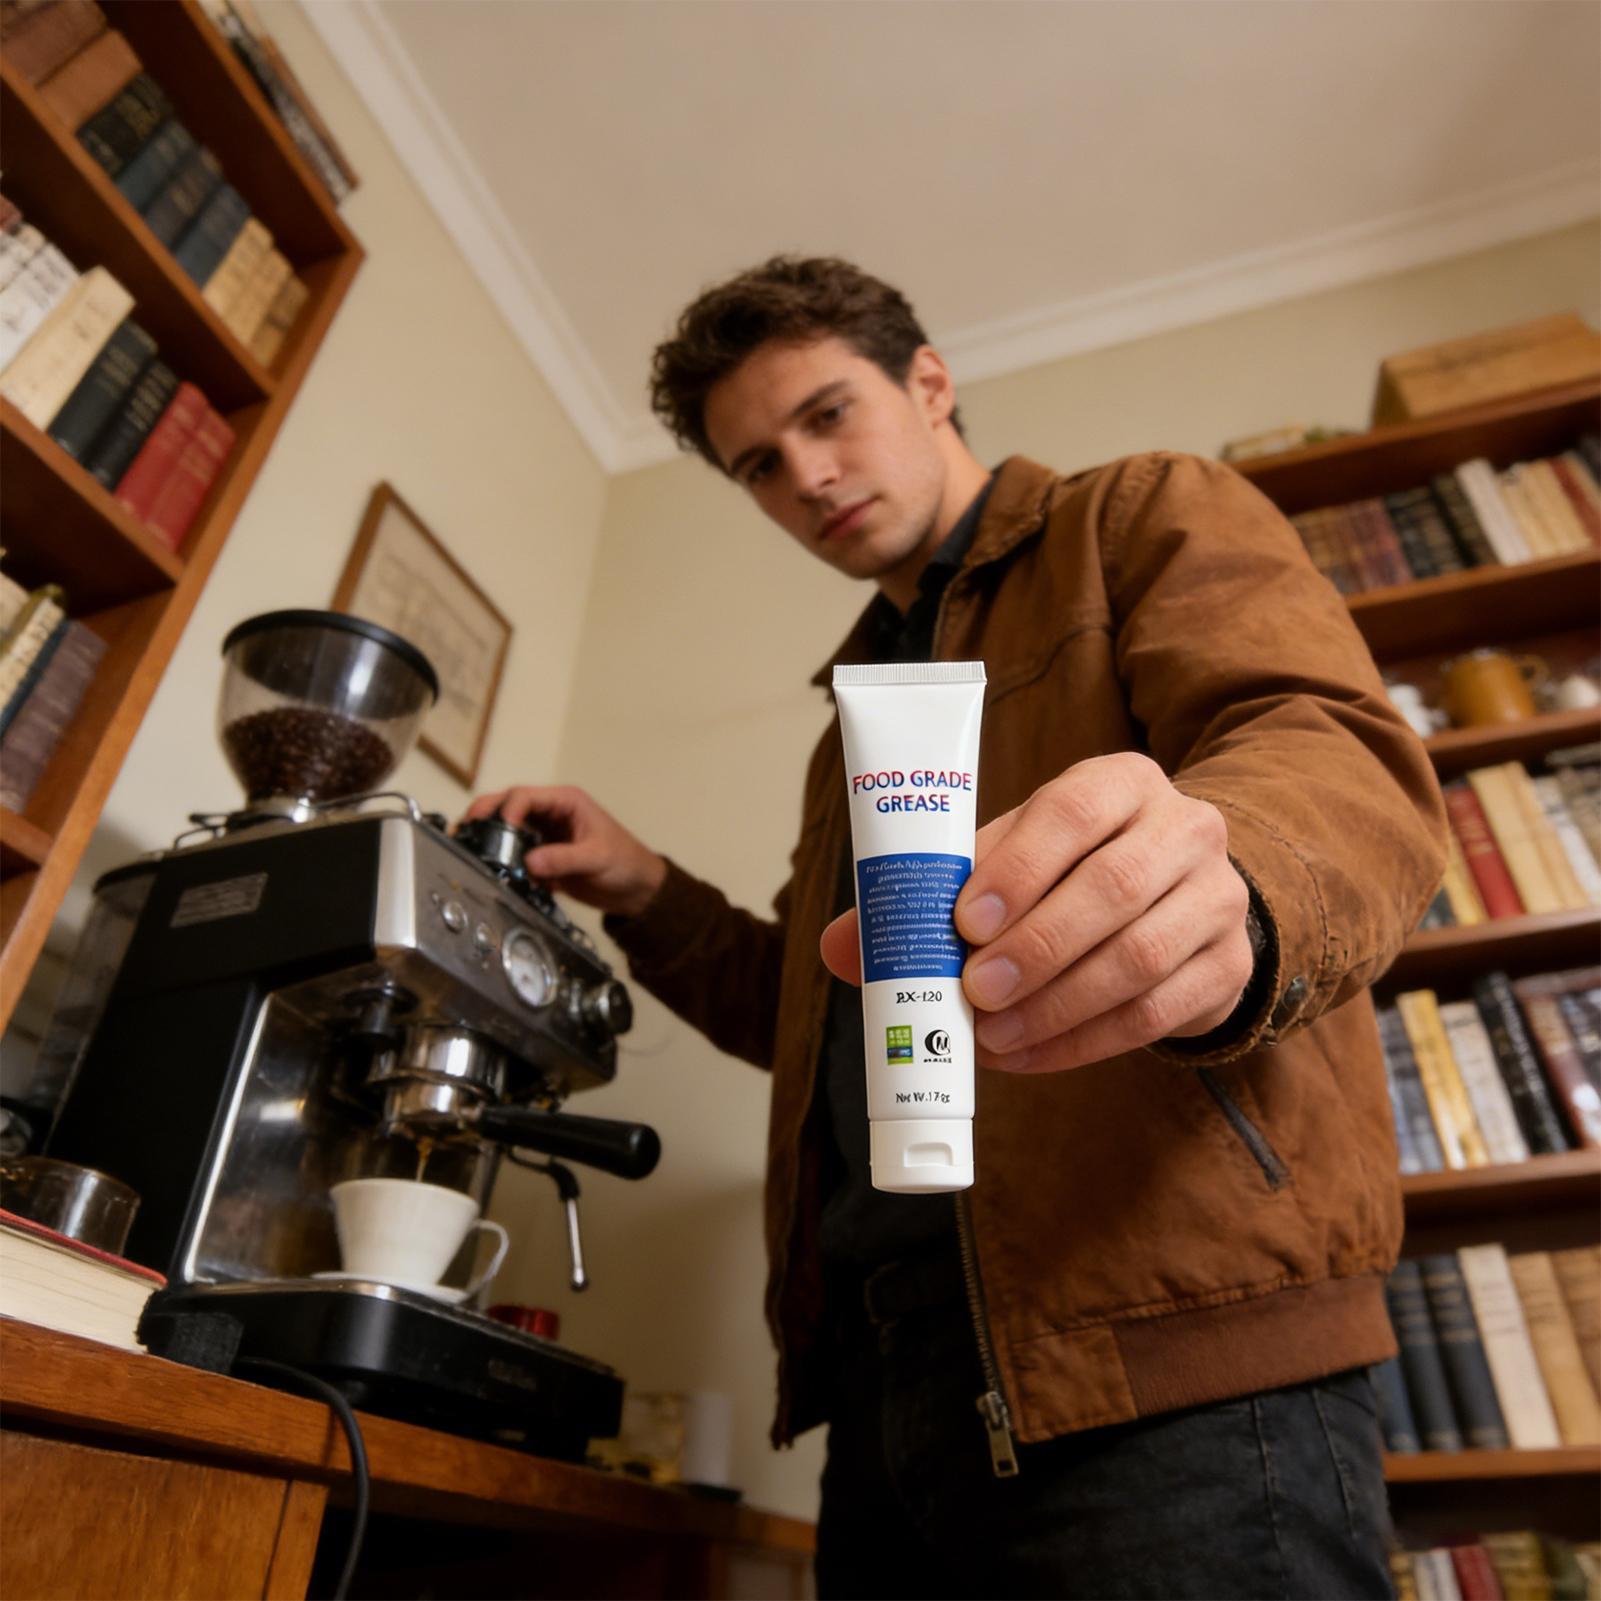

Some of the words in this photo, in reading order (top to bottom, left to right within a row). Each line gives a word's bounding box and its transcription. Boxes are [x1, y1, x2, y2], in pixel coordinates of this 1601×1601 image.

[852, 771, 905, 795] FOOD
[910, 770, 972, 791] GRADE
[876, 794, 950, 813] GREASE
